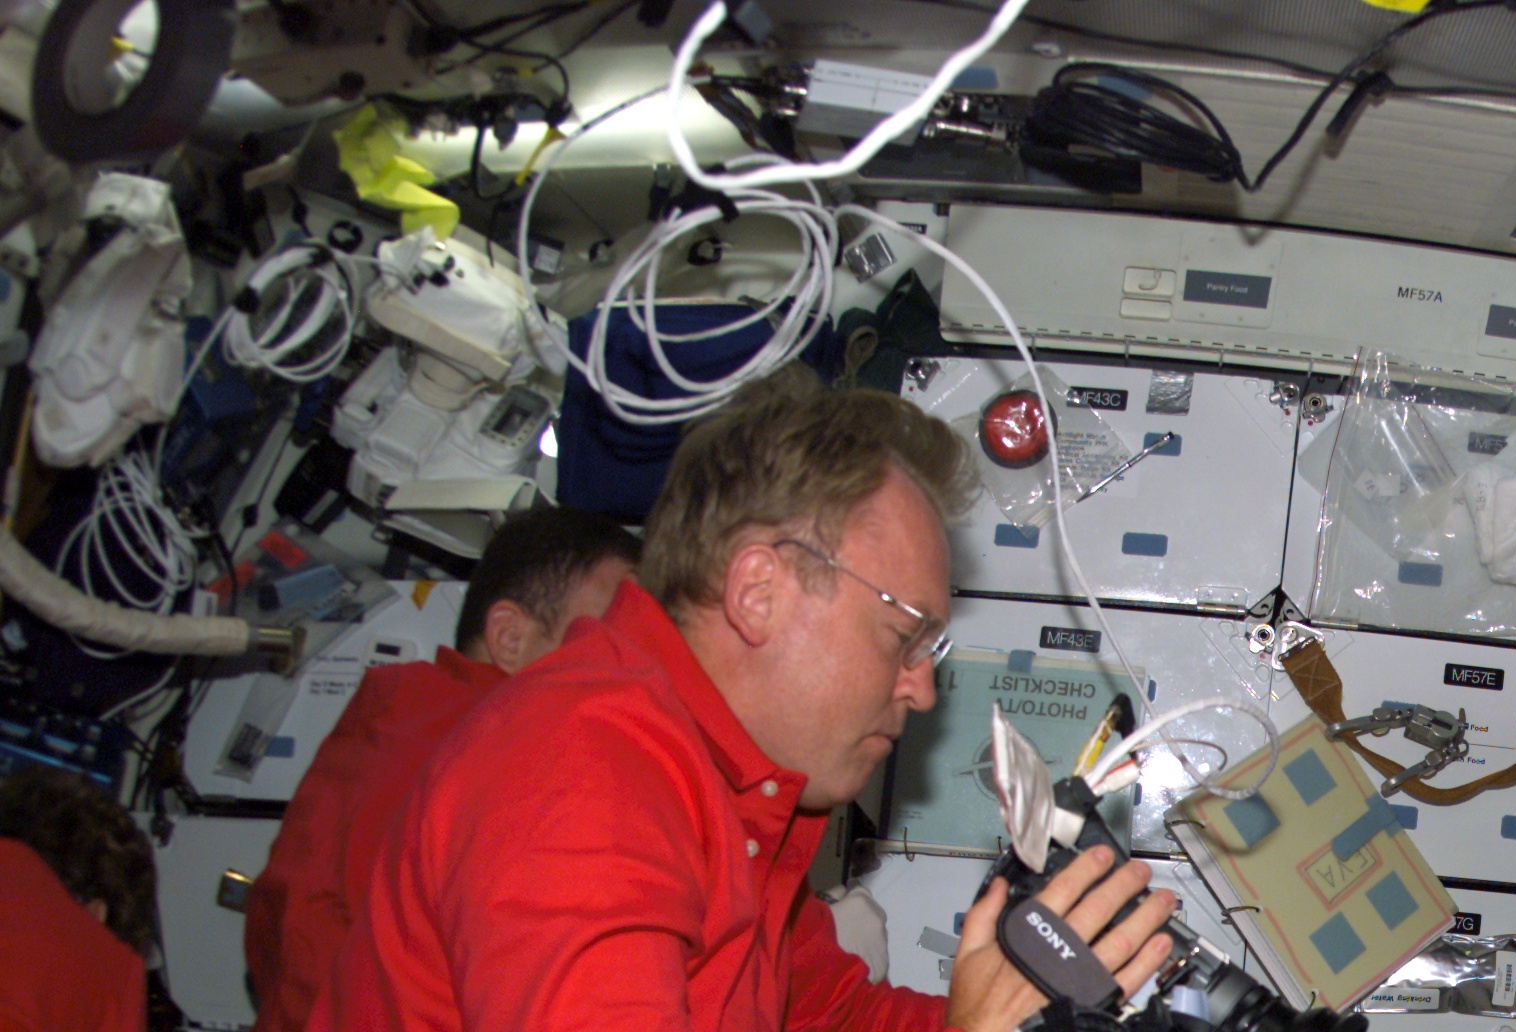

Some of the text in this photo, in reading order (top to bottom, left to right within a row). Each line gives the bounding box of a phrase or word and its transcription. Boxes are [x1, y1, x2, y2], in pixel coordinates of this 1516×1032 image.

[1397, 286, 1443, 304] MF57A
[1047, 631, 1094, 648] MF43E
[1452, 668, 1496, 686] MF57E
[989, 674, 1096, 699] CHECKLIST
[1025, 911, 1077, 960] SONY
